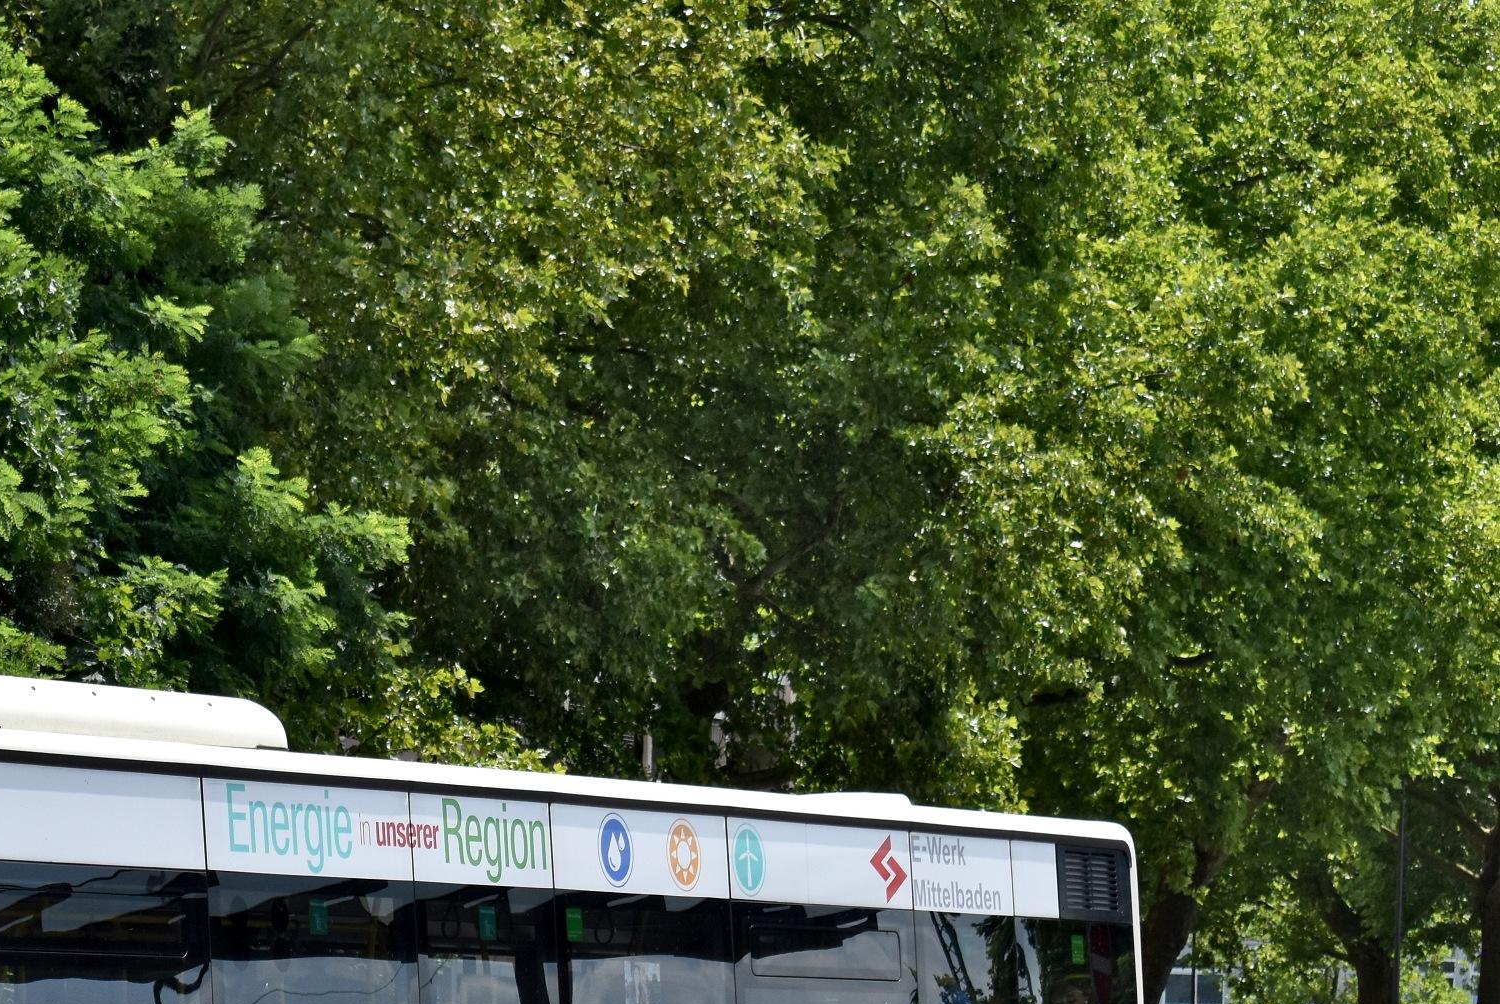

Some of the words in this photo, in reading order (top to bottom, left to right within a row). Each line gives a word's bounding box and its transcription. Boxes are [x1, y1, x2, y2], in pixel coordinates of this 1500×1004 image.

[227, 783, 352, 873] Energie
[375, 819, 439, 849] unserer
[441, 797, 548, 884] Region
[912, 836, 966, 866] E-Werk
[913, 879, 1001, 910] Mittelbaden
